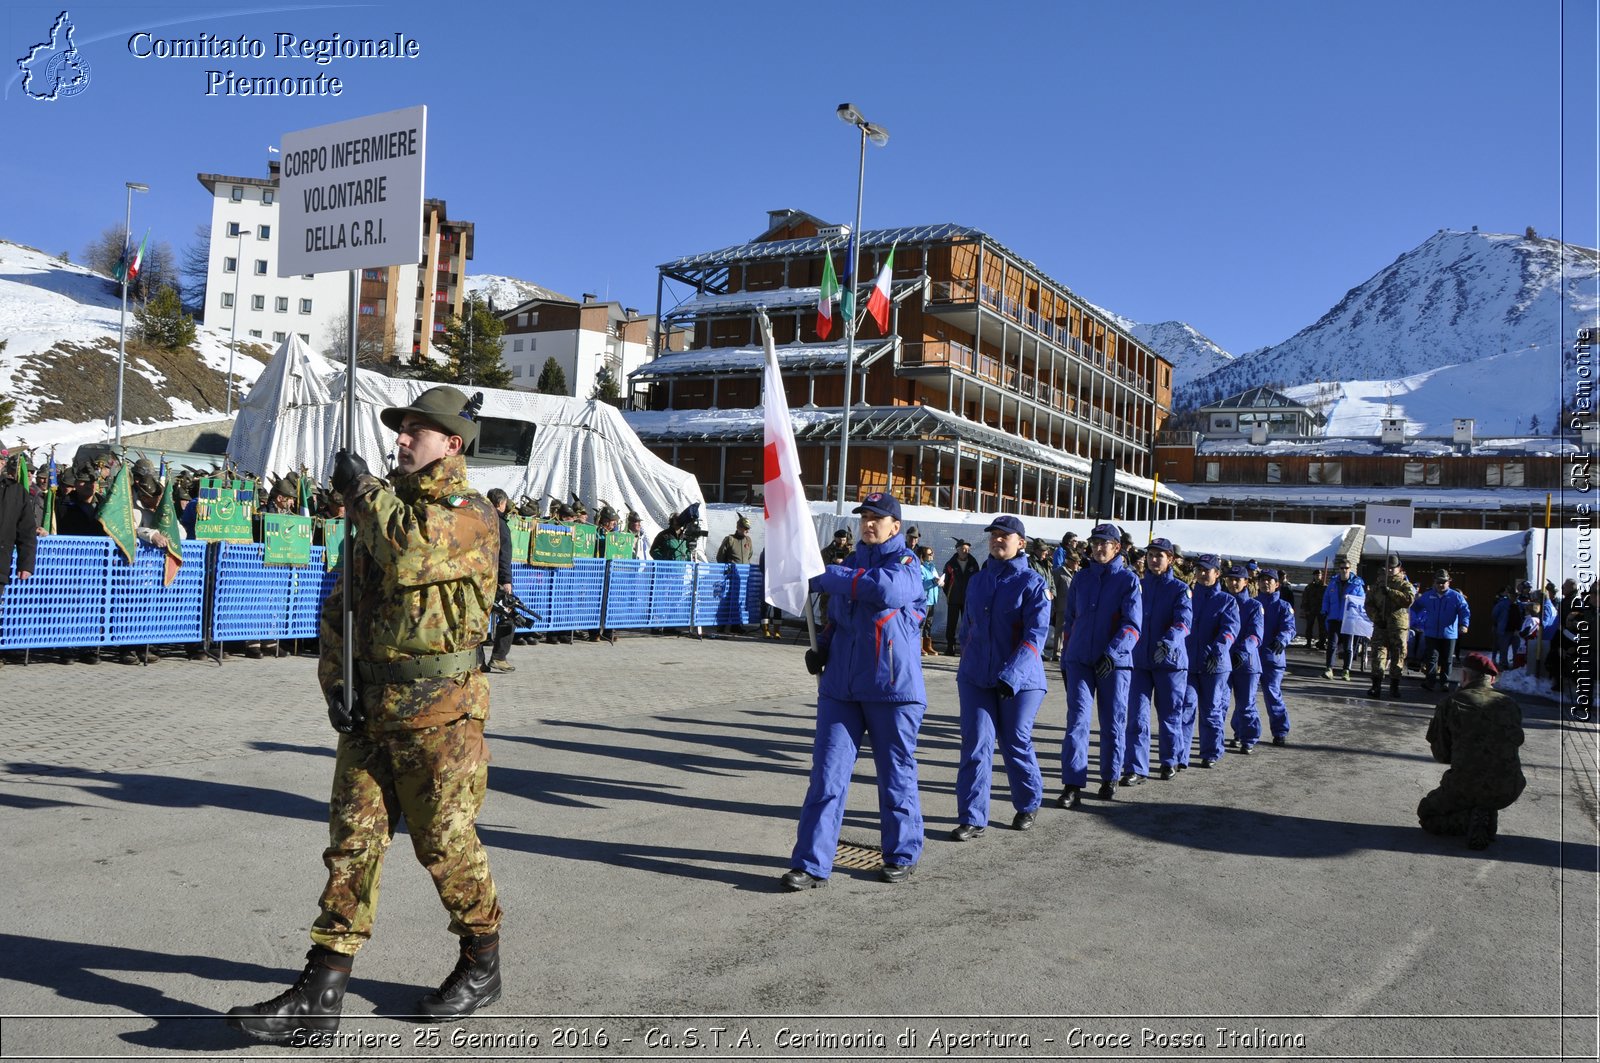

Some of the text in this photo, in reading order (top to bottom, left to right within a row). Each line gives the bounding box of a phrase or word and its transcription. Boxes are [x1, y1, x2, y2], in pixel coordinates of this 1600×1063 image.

[284, 128, 417, 179] CORPO INFERMIERE
[303, 175, 387, 214] VOLONTARIE
[305, 218, 387, 253] DELLA C.R.I.
[1377, 517, 1401, 526] FISIP
